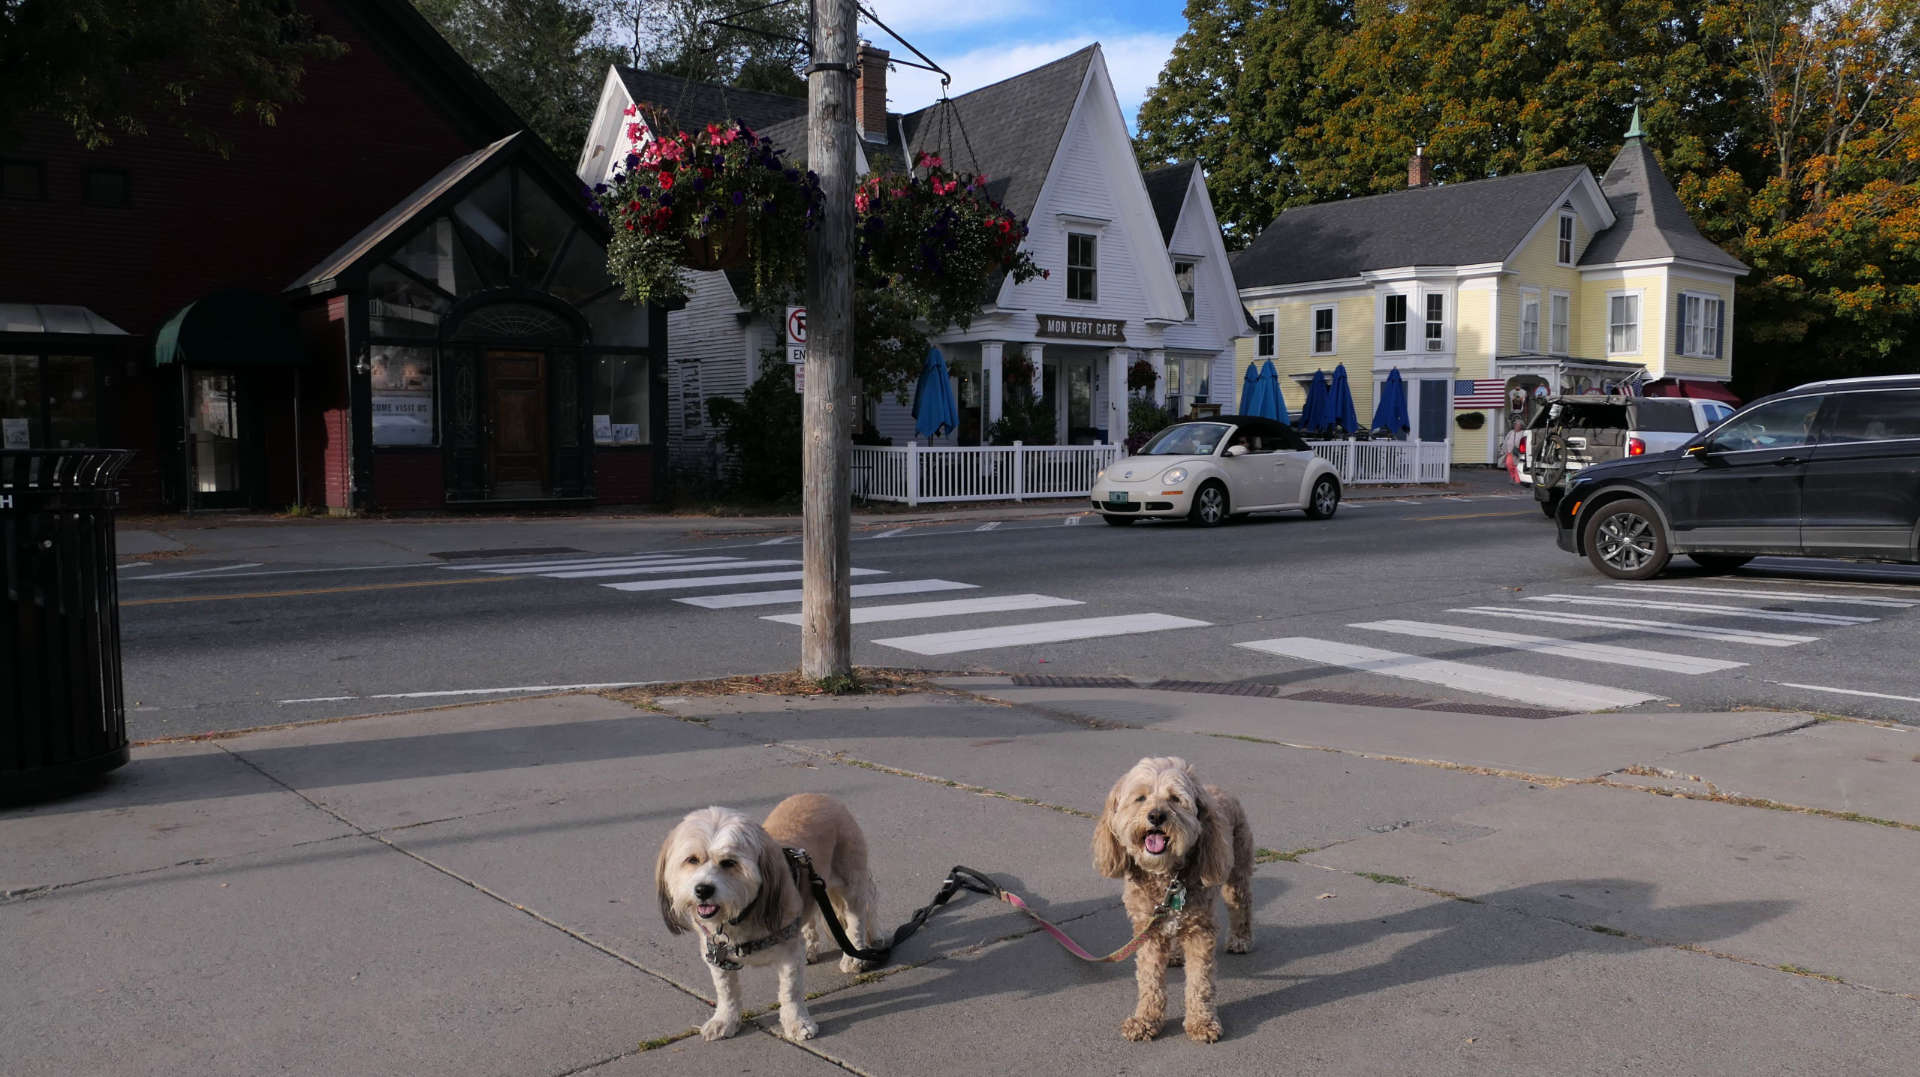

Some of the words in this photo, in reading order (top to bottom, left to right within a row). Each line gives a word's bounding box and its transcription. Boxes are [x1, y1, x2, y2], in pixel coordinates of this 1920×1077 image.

[1047, 320, 1067, 333] MON
[1071, 321, 1093, 335] VERT
[1096, 323, 1118, 336] CAFE
[395, 403, 415, 412] VISIT
[417, 404, 428, 412] US
